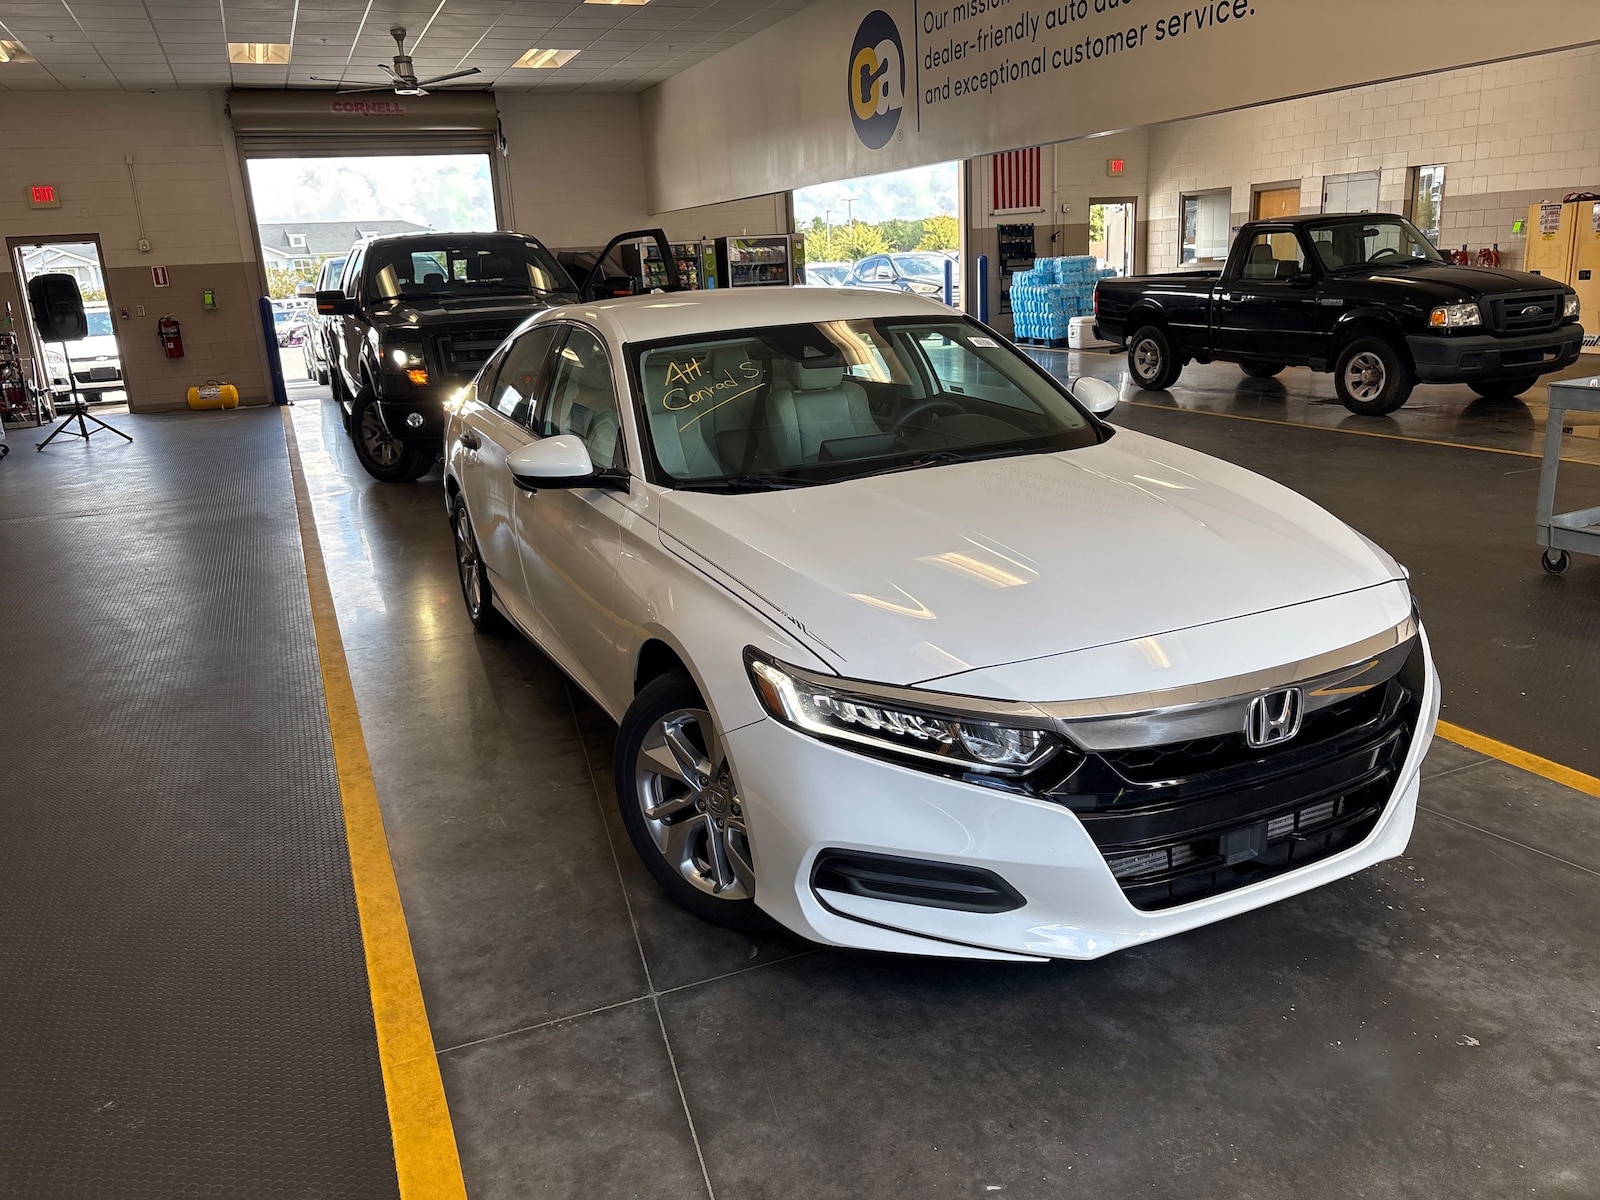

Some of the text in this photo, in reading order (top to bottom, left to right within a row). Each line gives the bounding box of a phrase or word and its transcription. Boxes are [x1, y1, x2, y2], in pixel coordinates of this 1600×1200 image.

[923, 0, 1009, 34] Our missio
[924, 11, 1040, 70] dealer-friendly
[1045, 0, 1088, 30] auto
[925, 0, 1255, 104] and exceptional customer service.
[332, 102, 404, 114] CORNELL
[32, 187, 54, 203] EXIT
[662, 369, 738, 410] Conrad
